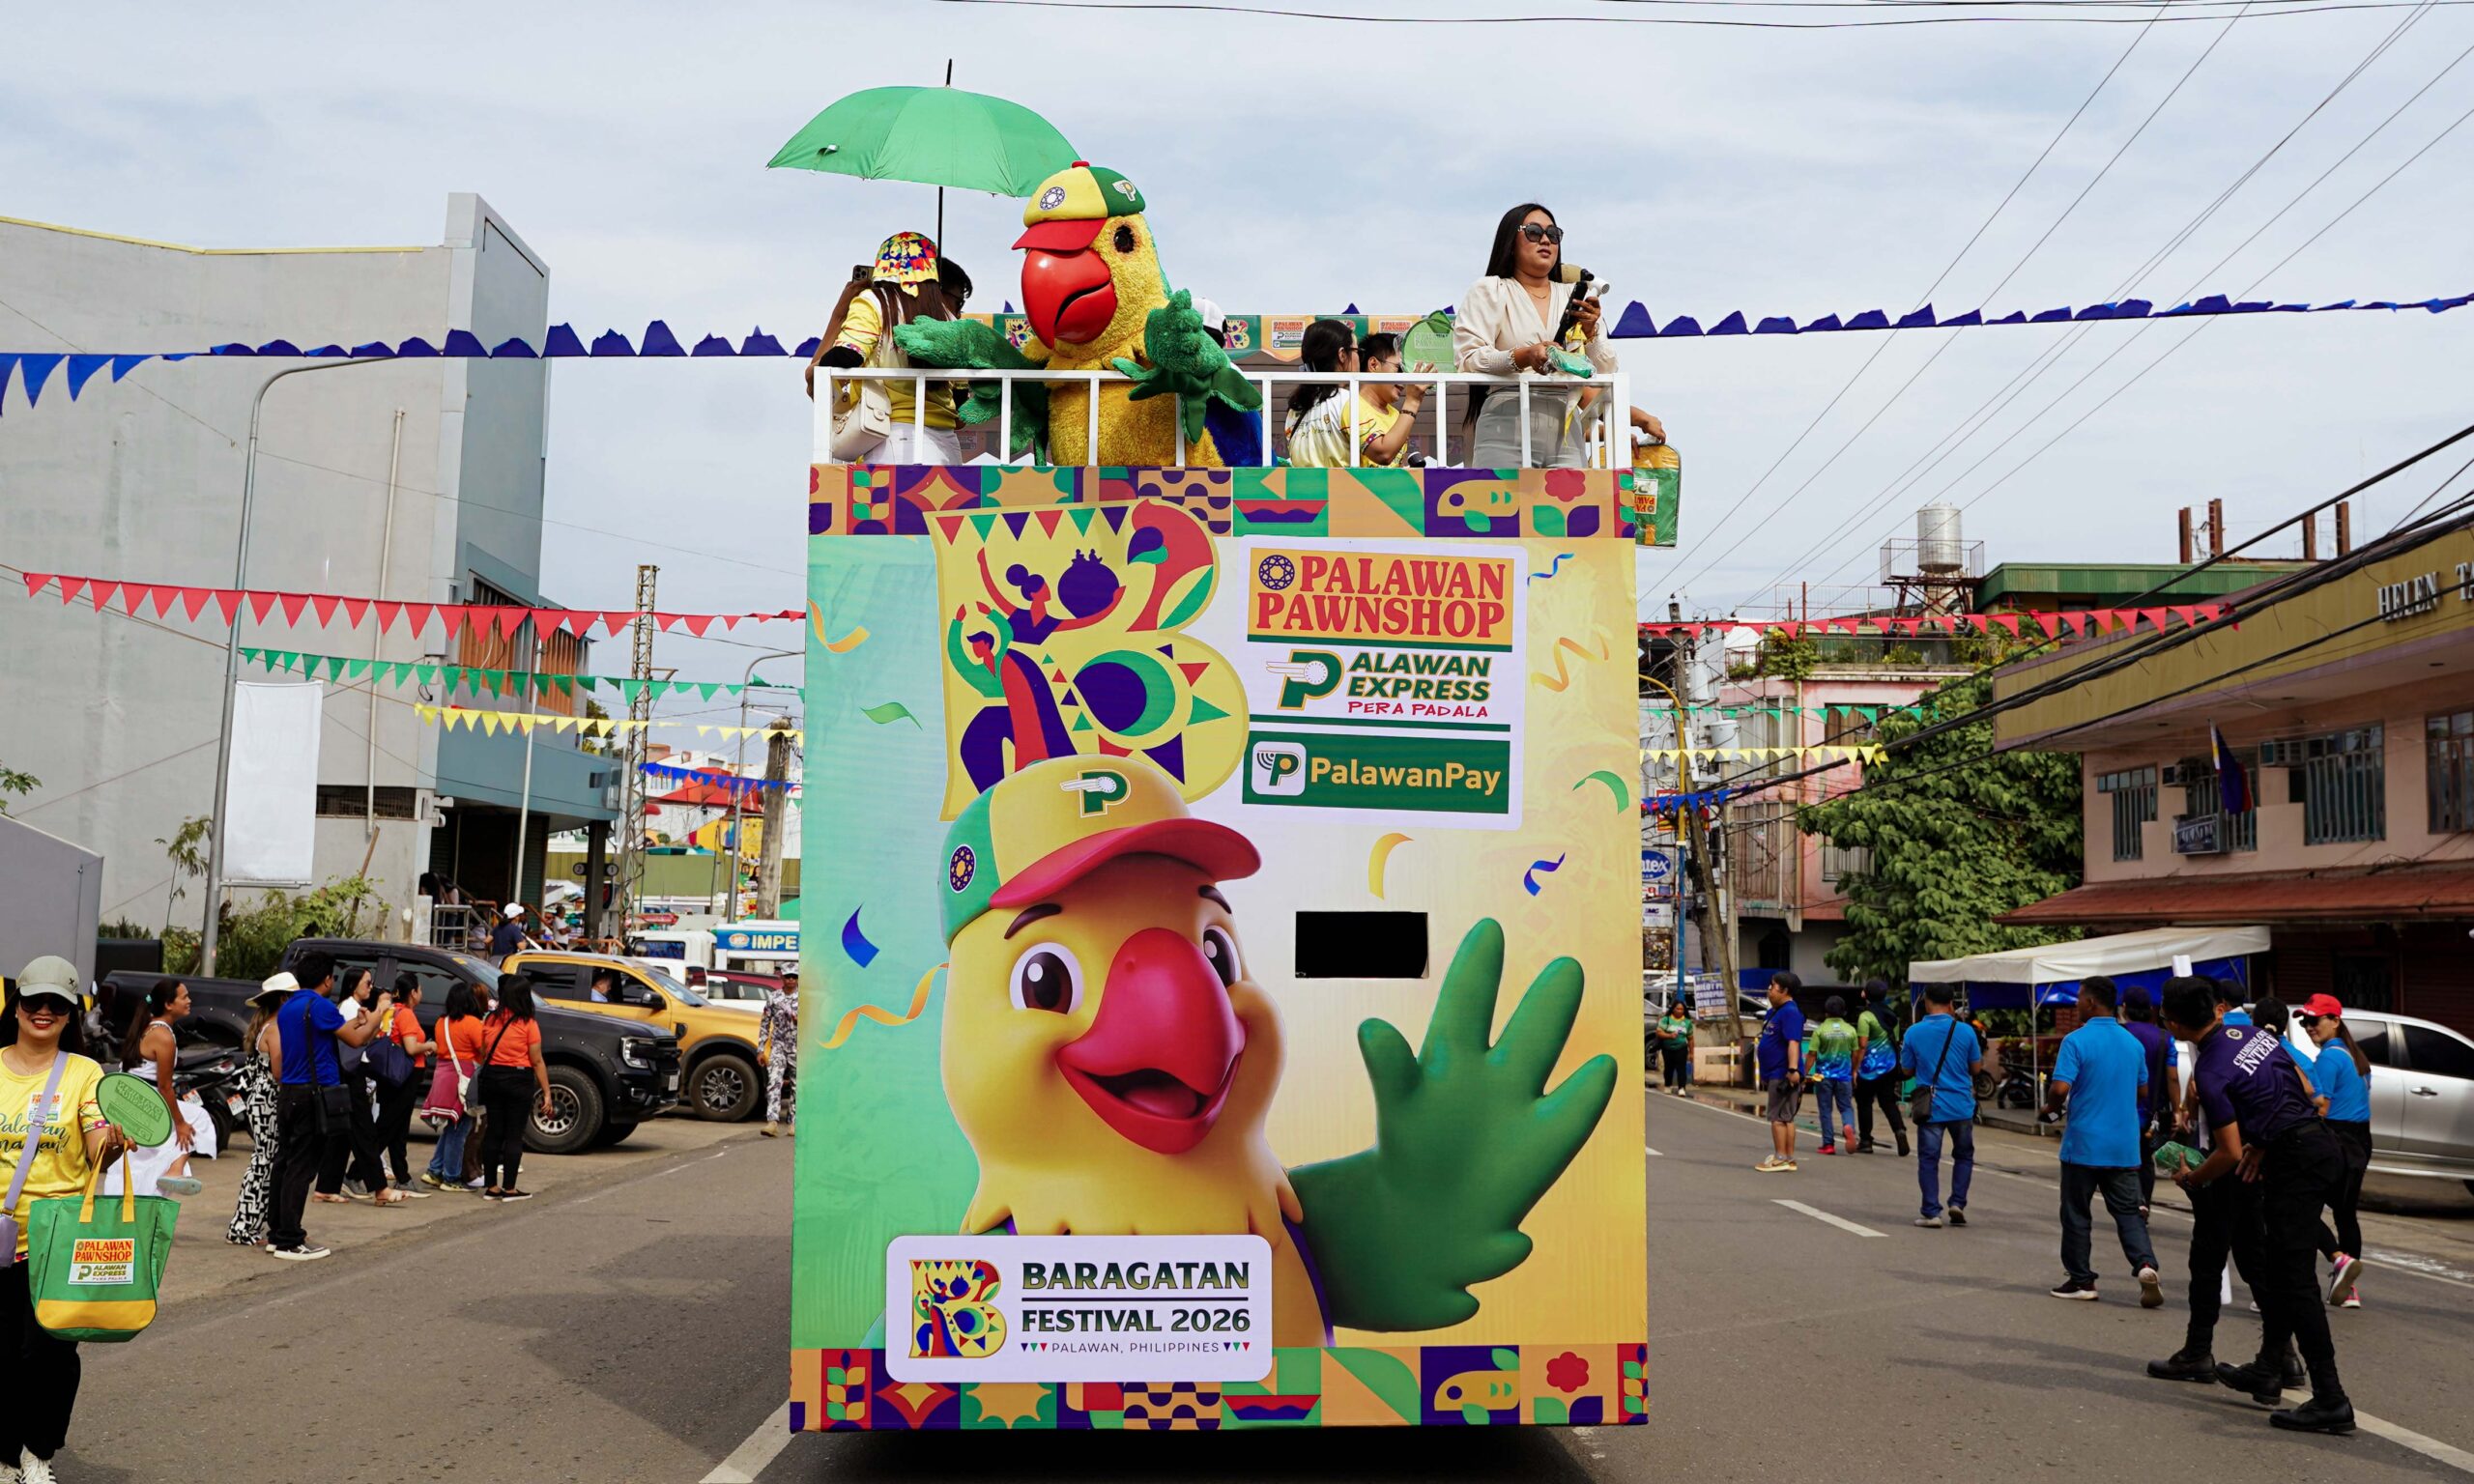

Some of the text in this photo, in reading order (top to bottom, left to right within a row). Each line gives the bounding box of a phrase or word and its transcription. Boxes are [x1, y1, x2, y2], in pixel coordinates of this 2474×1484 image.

[1300, 555, 1506, 601] PALAWAN
[2377, 571, 2440, 622] HELEN
[1256, 591, 1505, 639] PAWNSHOP
[1346, 675, 1492, 702] EXPRESS
[1347, 700, 1488, 718] PERA PADALA
[1310, 756, 1501, 796] PalawanPay
[752, 934, 798, 951] IMPE
[0, 1113, 66, 1140] alaan
[74, 1250, 132, 1262] PAWNSHOP
[84, 1241, 132, 1251] PALAWAN
[1021, 1261, 1250, 1290] BARAGATAN
[1021, 1308, 1251, 1333] FESTIVAL 2026
[1051, 1341, 1220, 1355] PALAWAN, PHILIPPINES
